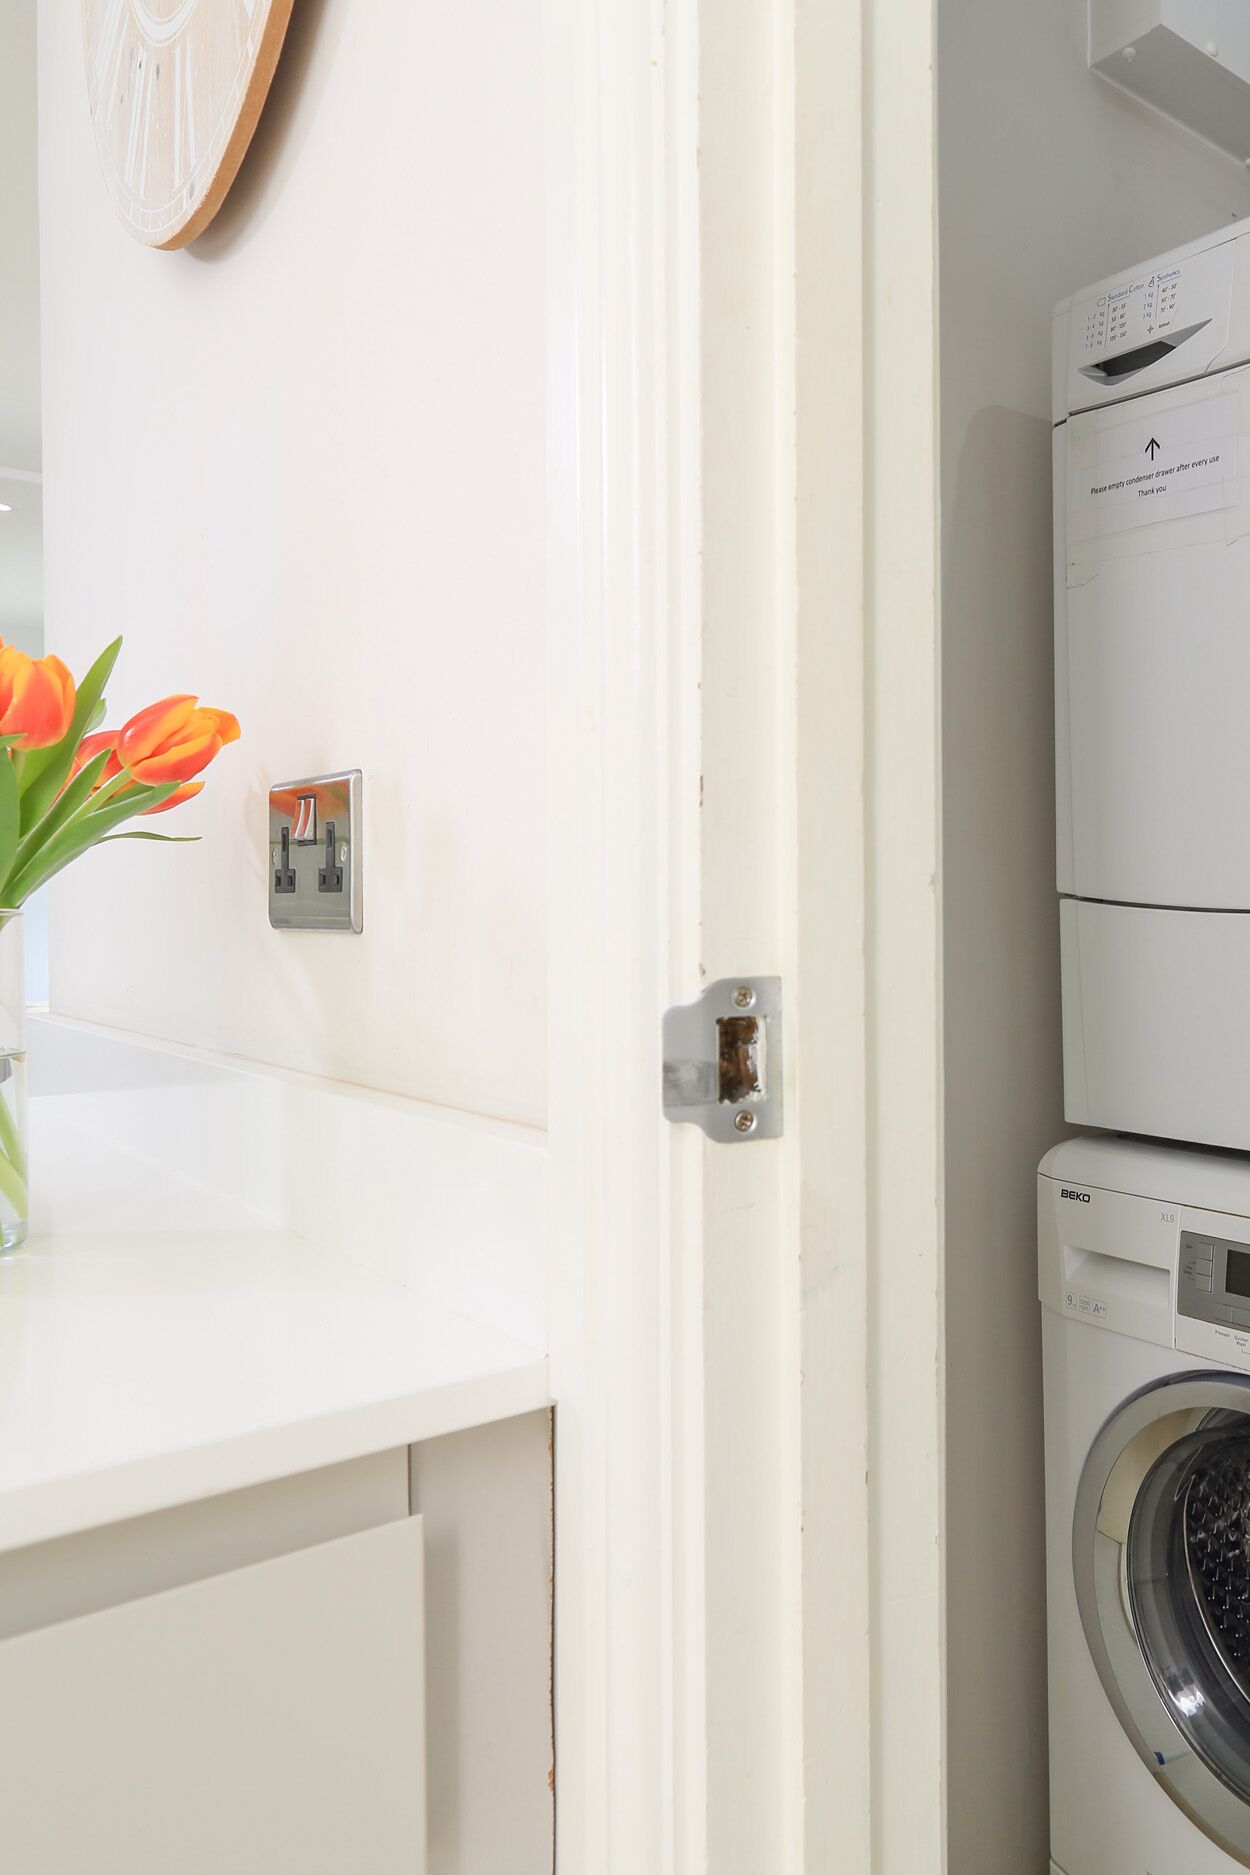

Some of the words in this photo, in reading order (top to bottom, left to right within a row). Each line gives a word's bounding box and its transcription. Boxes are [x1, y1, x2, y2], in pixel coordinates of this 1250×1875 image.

[1090, 485, 1108, 496] Please
[1108, 480, 1126, 491] empty
[1125, 473, 1155, 486] condenser
[1155, 467, 1176, 478] drawer
[1176, 463, 1191, 473] after
[1191, 459, 1208, 469] every
[1209, 455, 1220, 464] use
[1138, 486, 1155, 498] Thank
[1156, 485, 1167, 494] you
[1060, 1189, 1091, 1203] BEKO
[1160, 1212, 1175, 1224] XL9
[1067, 1294, 1073, 1306] 9
